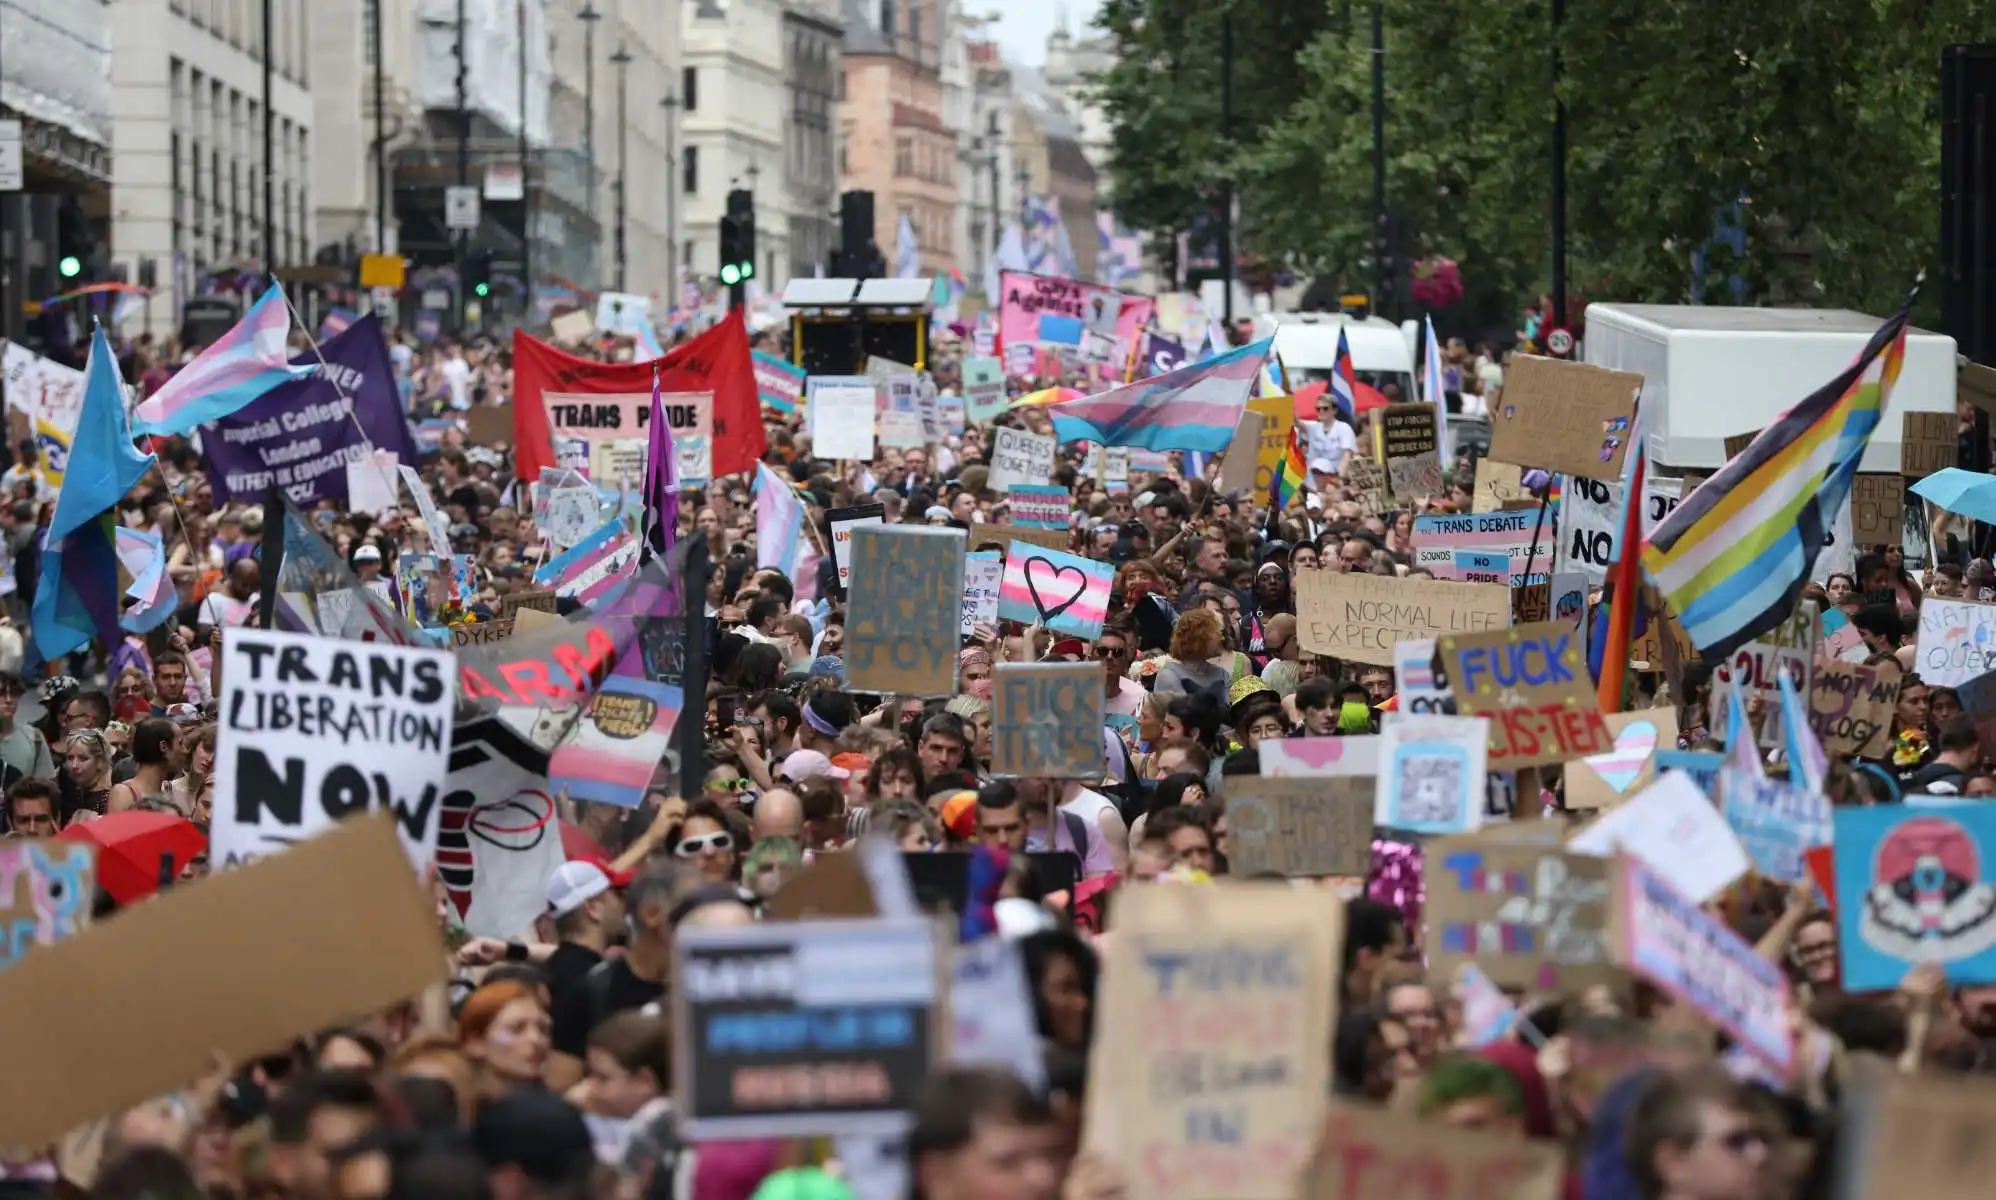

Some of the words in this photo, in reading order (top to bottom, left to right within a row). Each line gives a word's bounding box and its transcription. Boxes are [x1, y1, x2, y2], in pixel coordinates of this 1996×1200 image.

[282, 396, 353, 432] College
[551, 404, 621, 428] TRANS
[637, 404, 697, 428] PIDE
[258, 437, 322, 467] London
[1000, 432, 1052, 458] QUEERS
[996, 455, 1049, 478] TOGETHER
[1851, 477, 1900, 501] RANS
[1016, 506, 1065, 521] SISTER
[1421, 550, 1450, 561] SOUNDS
[1571, 528, 1613, 566] NO
[1474, 558, 1490, 567] NO
[1466, 573, 1499, 583] PRIDE
[1345, 600, 1441, 629] NORMAL
[1450, 610, 1499, 632] LIFE
[1922, 605, 1996, 632] NATU
[850, 636, 954, 676] JOY
[1458, 634, 1575, 694] FUCK
[235, 642, 445, 704] TRANS
[1819, 671, 1865, 698] NOT
[228, 689, 444, 754] LIBERATION
[235, 746, 439, 843] NOW
